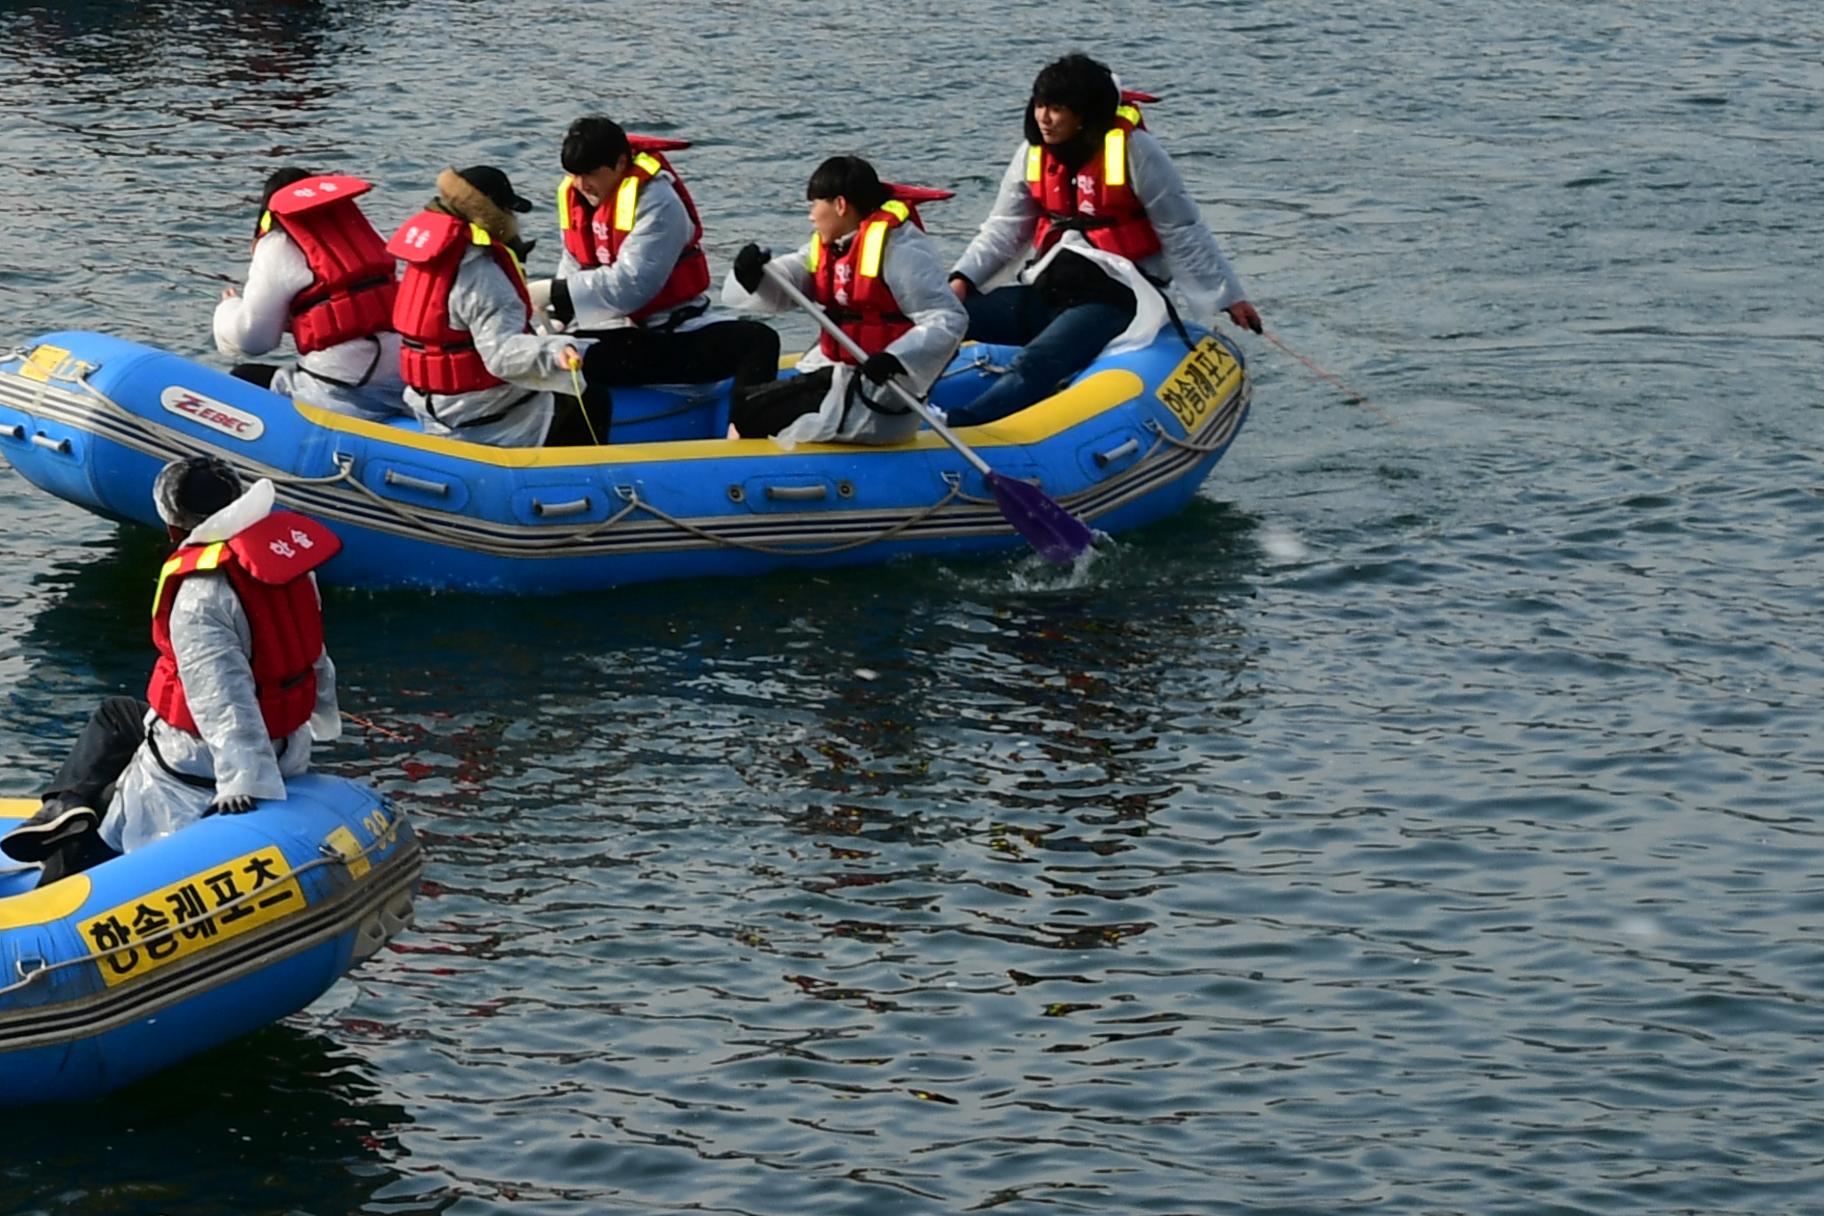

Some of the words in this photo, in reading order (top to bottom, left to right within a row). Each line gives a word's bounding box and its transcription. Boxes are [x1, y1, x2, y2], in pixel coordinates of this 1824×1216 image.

[173, 393, 252, 432] ZEBEC
[1162, 341, 1237, 426] 한솔레포츠
[89, 856, 294, 974] 한솔레포츠
